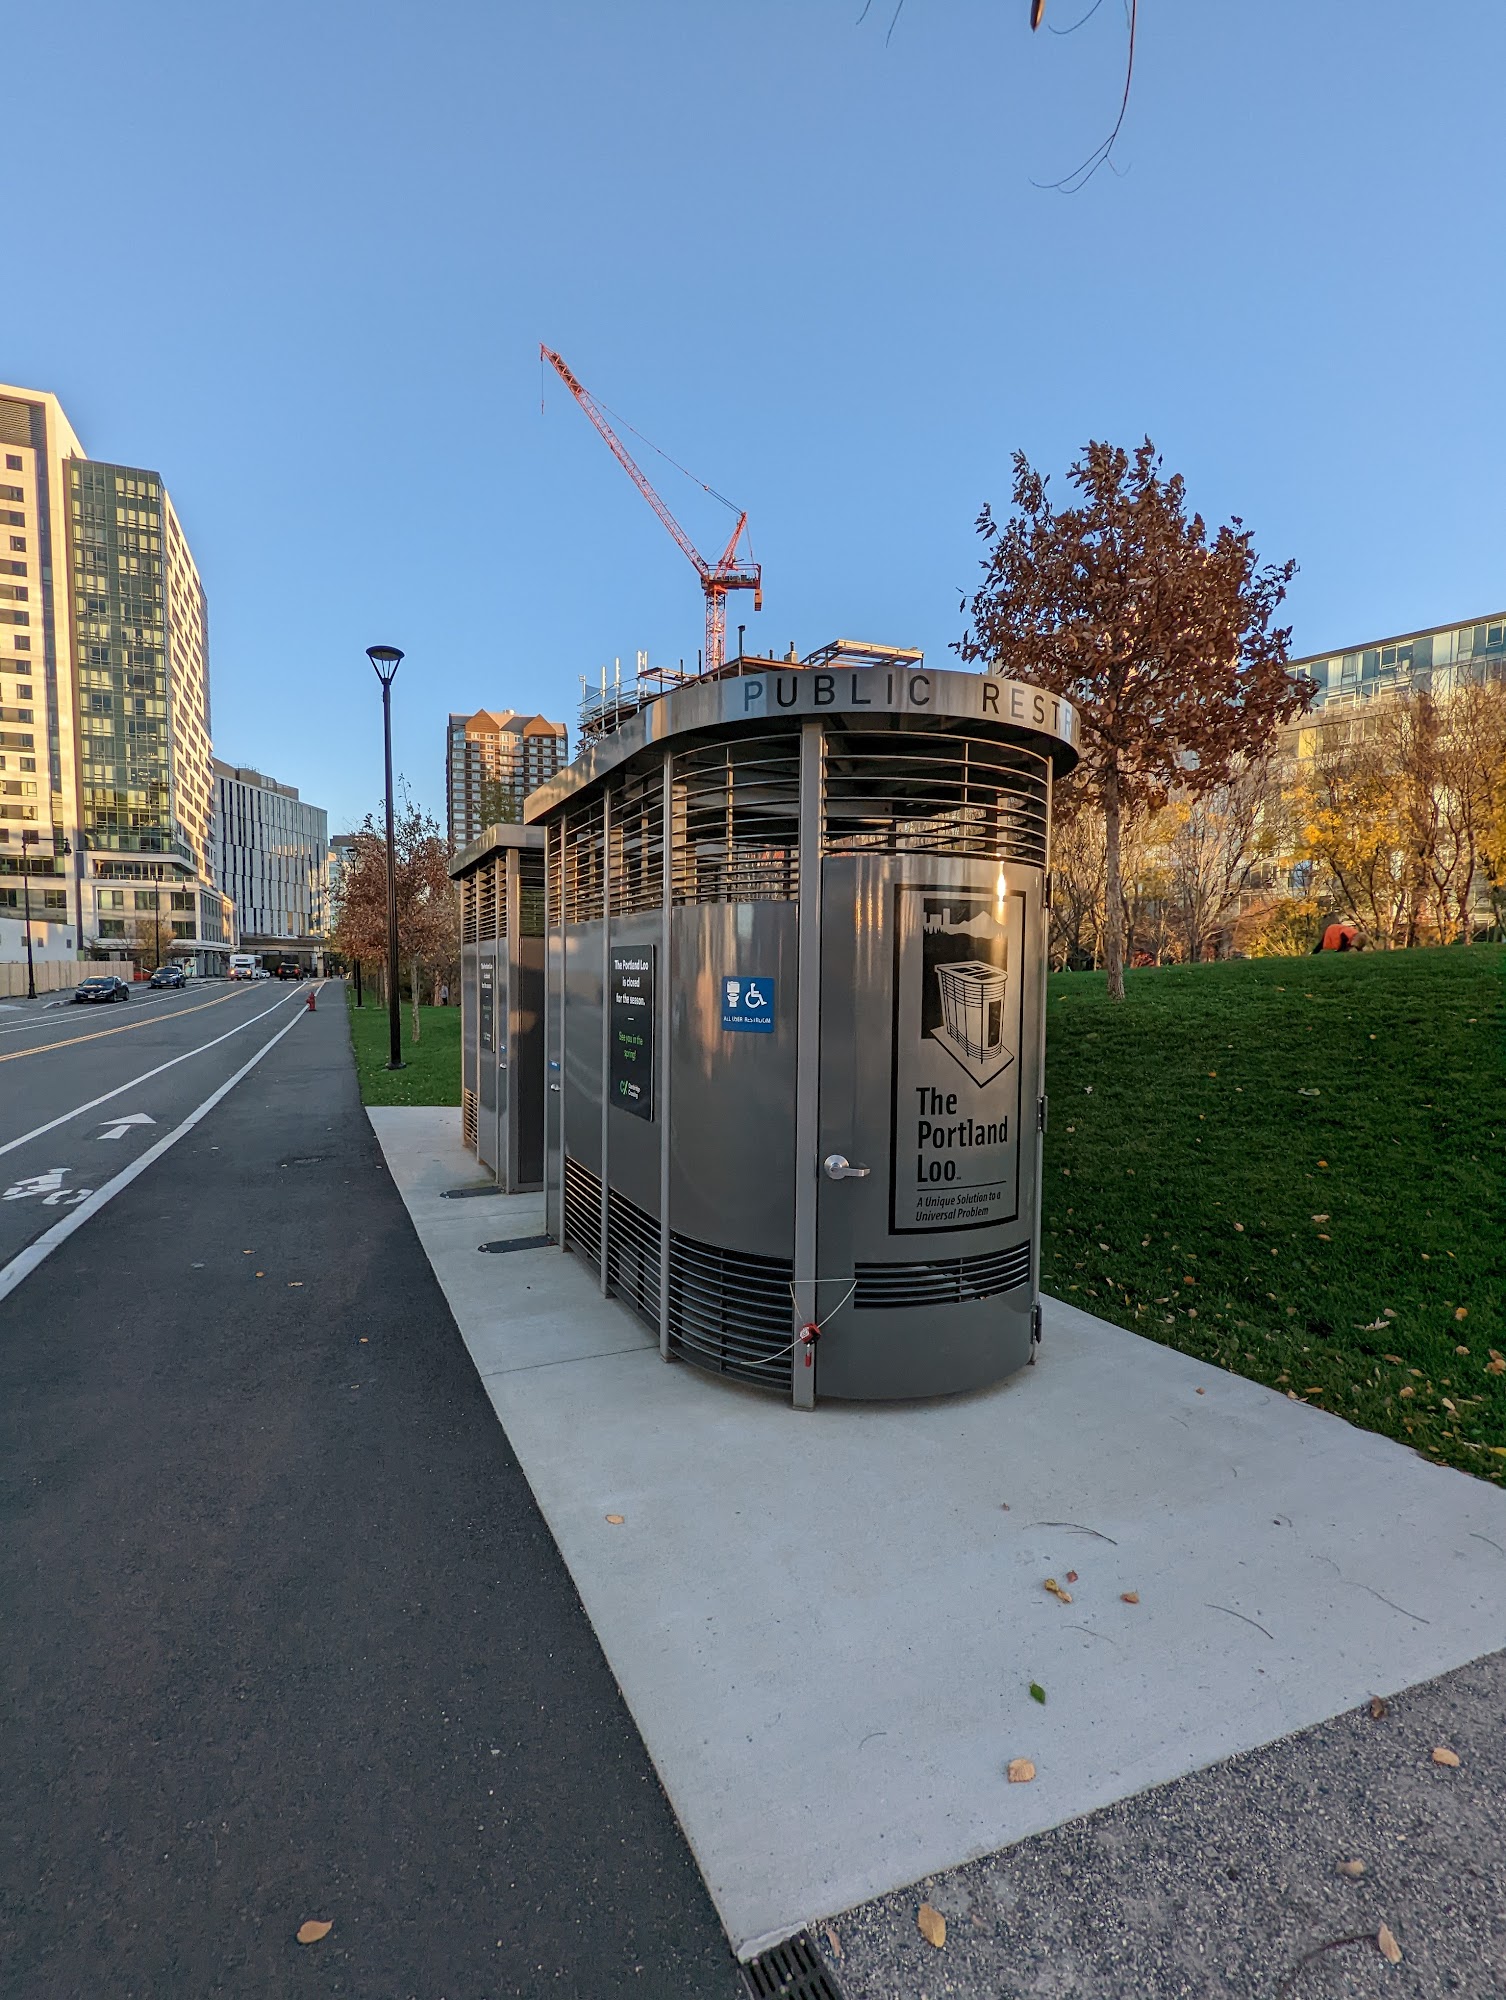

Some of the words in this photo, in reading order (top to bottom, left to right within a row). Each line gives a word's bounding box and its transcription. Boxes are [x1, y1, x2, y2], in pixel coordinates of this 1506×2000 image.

[744, 675, 930, 711] PUBLIC
[614, 959, 622, 970] The
[622, 959, 640, 970] Portland
[640, 959, 649, 970] Loo
[622, 976, 626, 987] is
[626, 976, 640, 987] closed
[629, 996, 645, 1006] season.
[744, 1016, 771, 1024] RESTROOM
[916, 1087, 957, 1115] The
[918, 1115, 1008, 1149] Portland
[917, 1154, 956, 1182] Loo
[916, 1197, 923, 1208] A
[925, 1195, 956, 1208] Unique
[956, 1192, 988, 1205] Solution
[988, 1191, 996, 1201] to
[996, 1191, 1001, 1200] a
[915, 1208, 957, 1221] Universal
[957, 1206, 989, 1219] Problem
